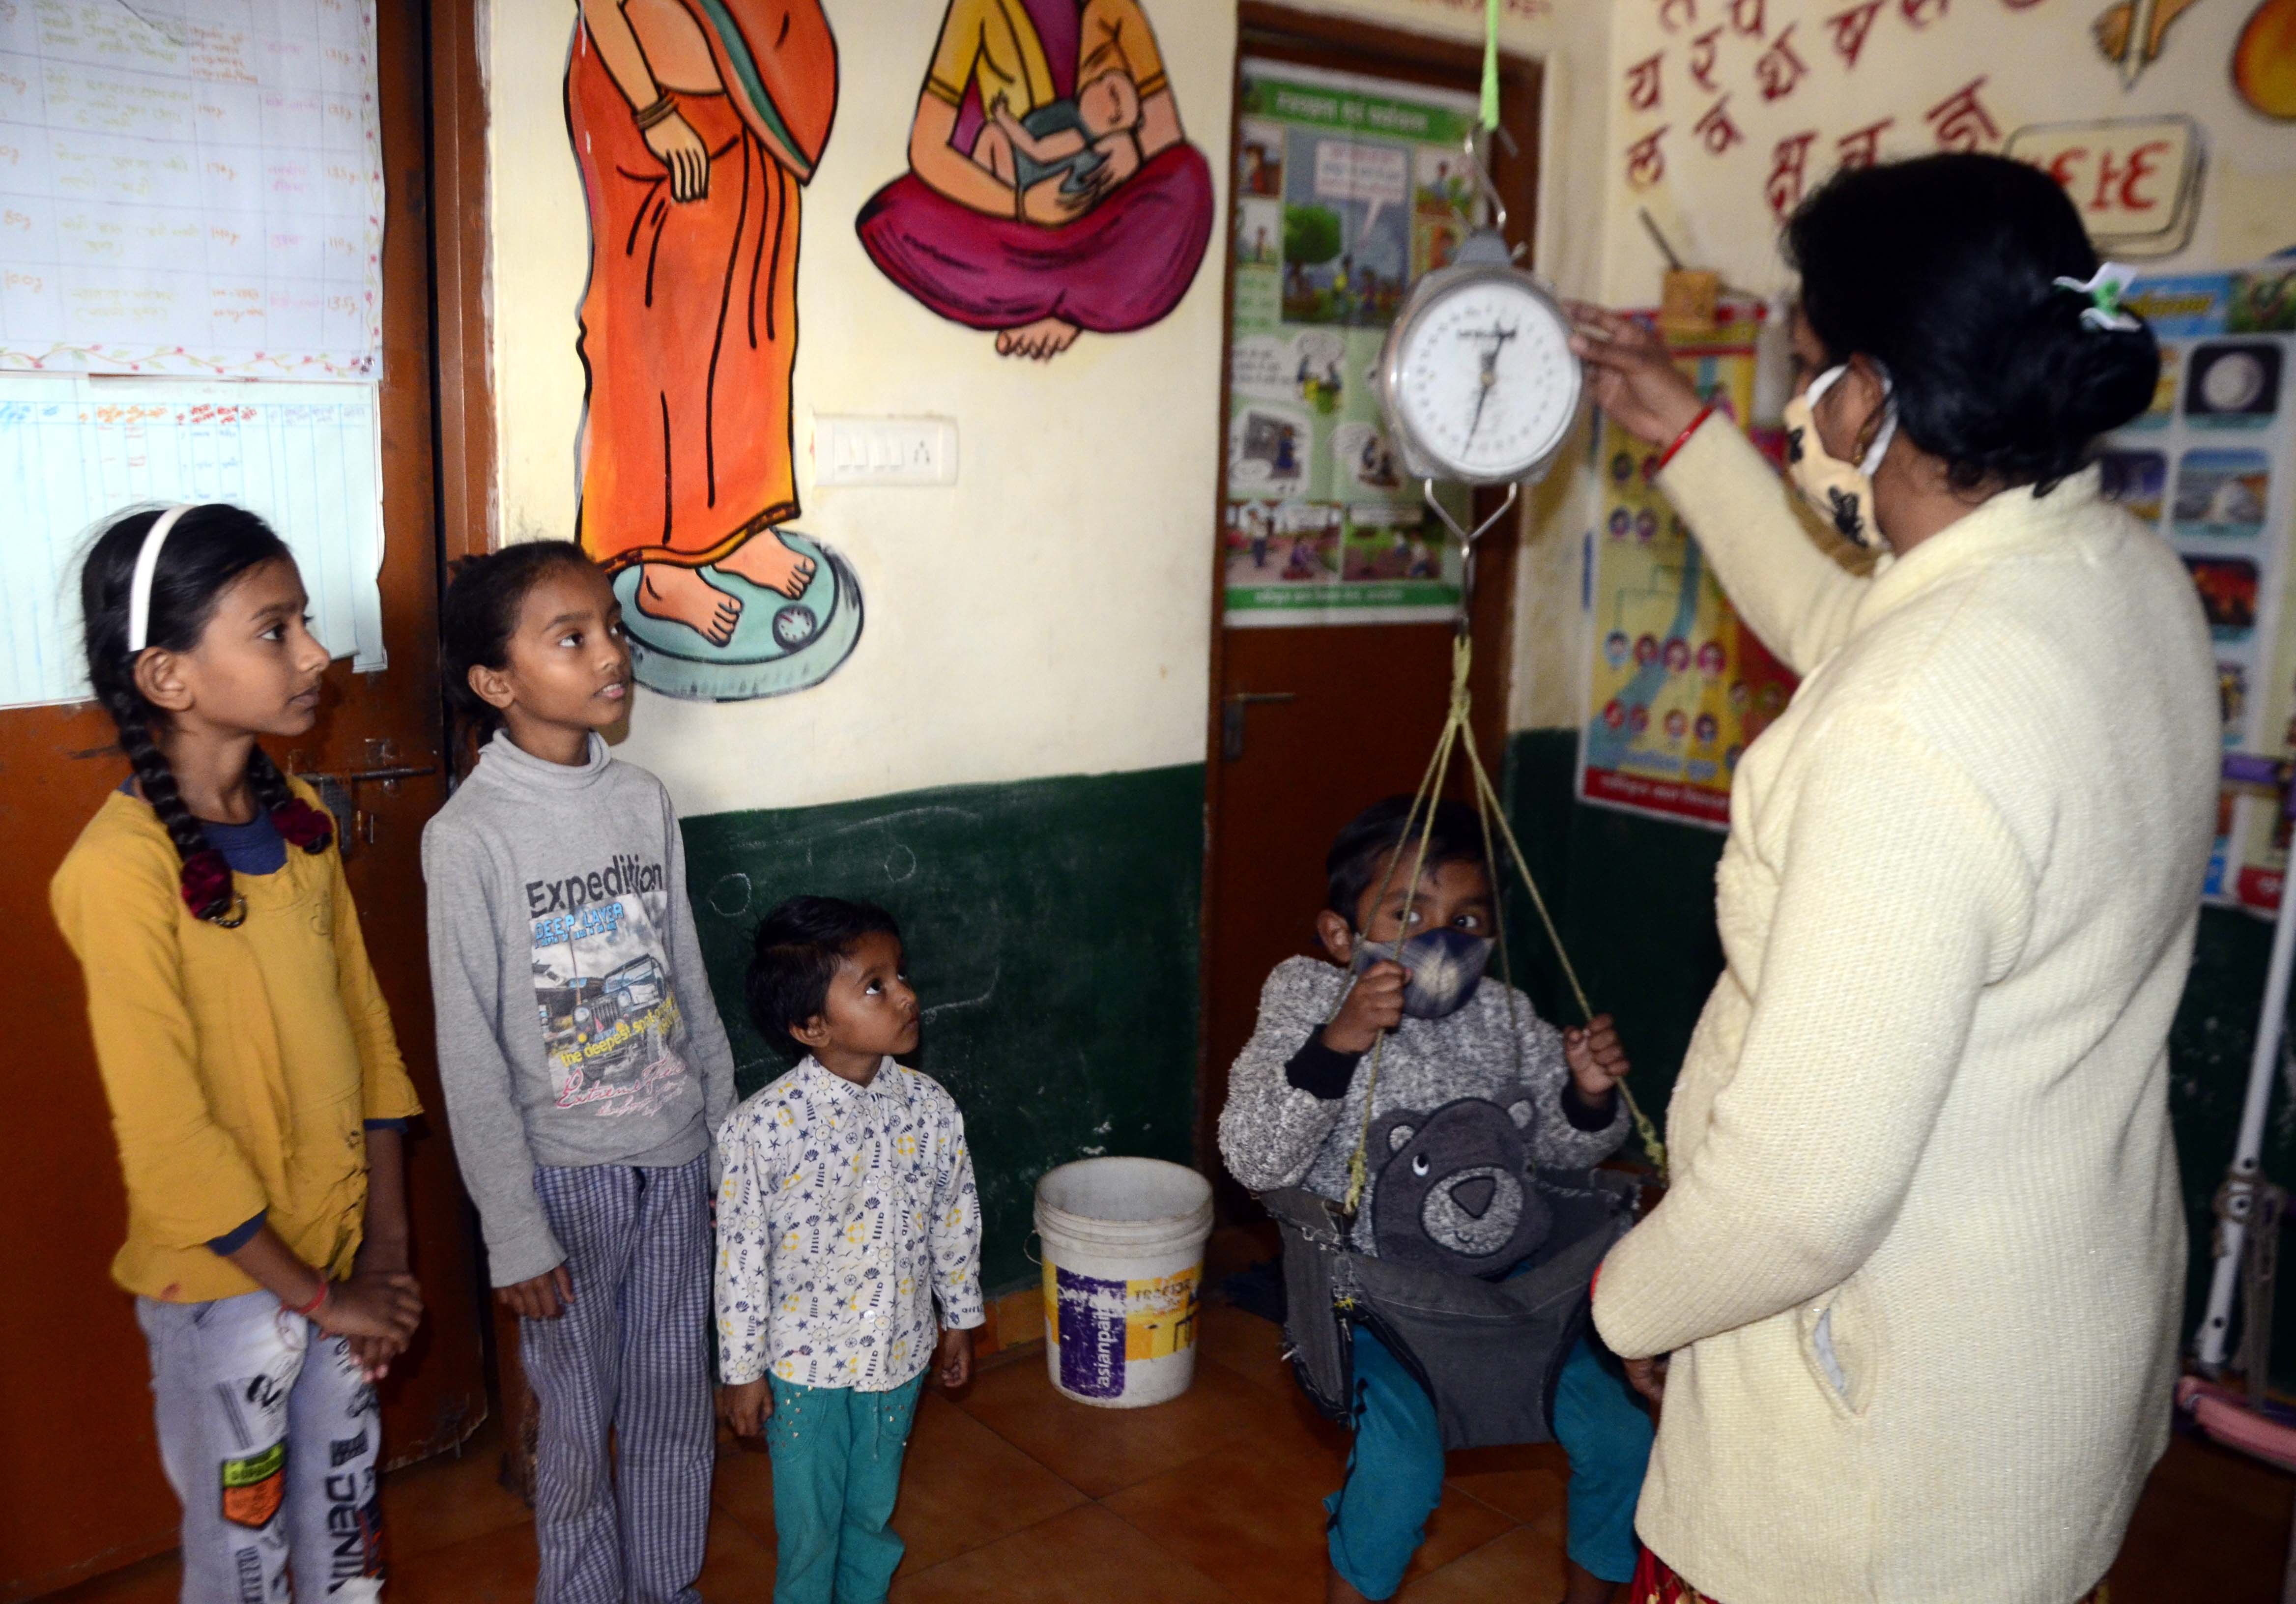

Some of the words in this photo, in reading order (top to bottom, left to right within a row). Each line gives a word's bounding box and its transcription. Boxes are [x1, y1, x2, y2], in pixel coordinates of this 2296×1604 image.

[526, 854, 663, 918] Expedition
[535, 914, 575, 941] DEEP
[582, 902, 624, 928] LAYER
[1094, 1297, 1119, 1387] asianpai
